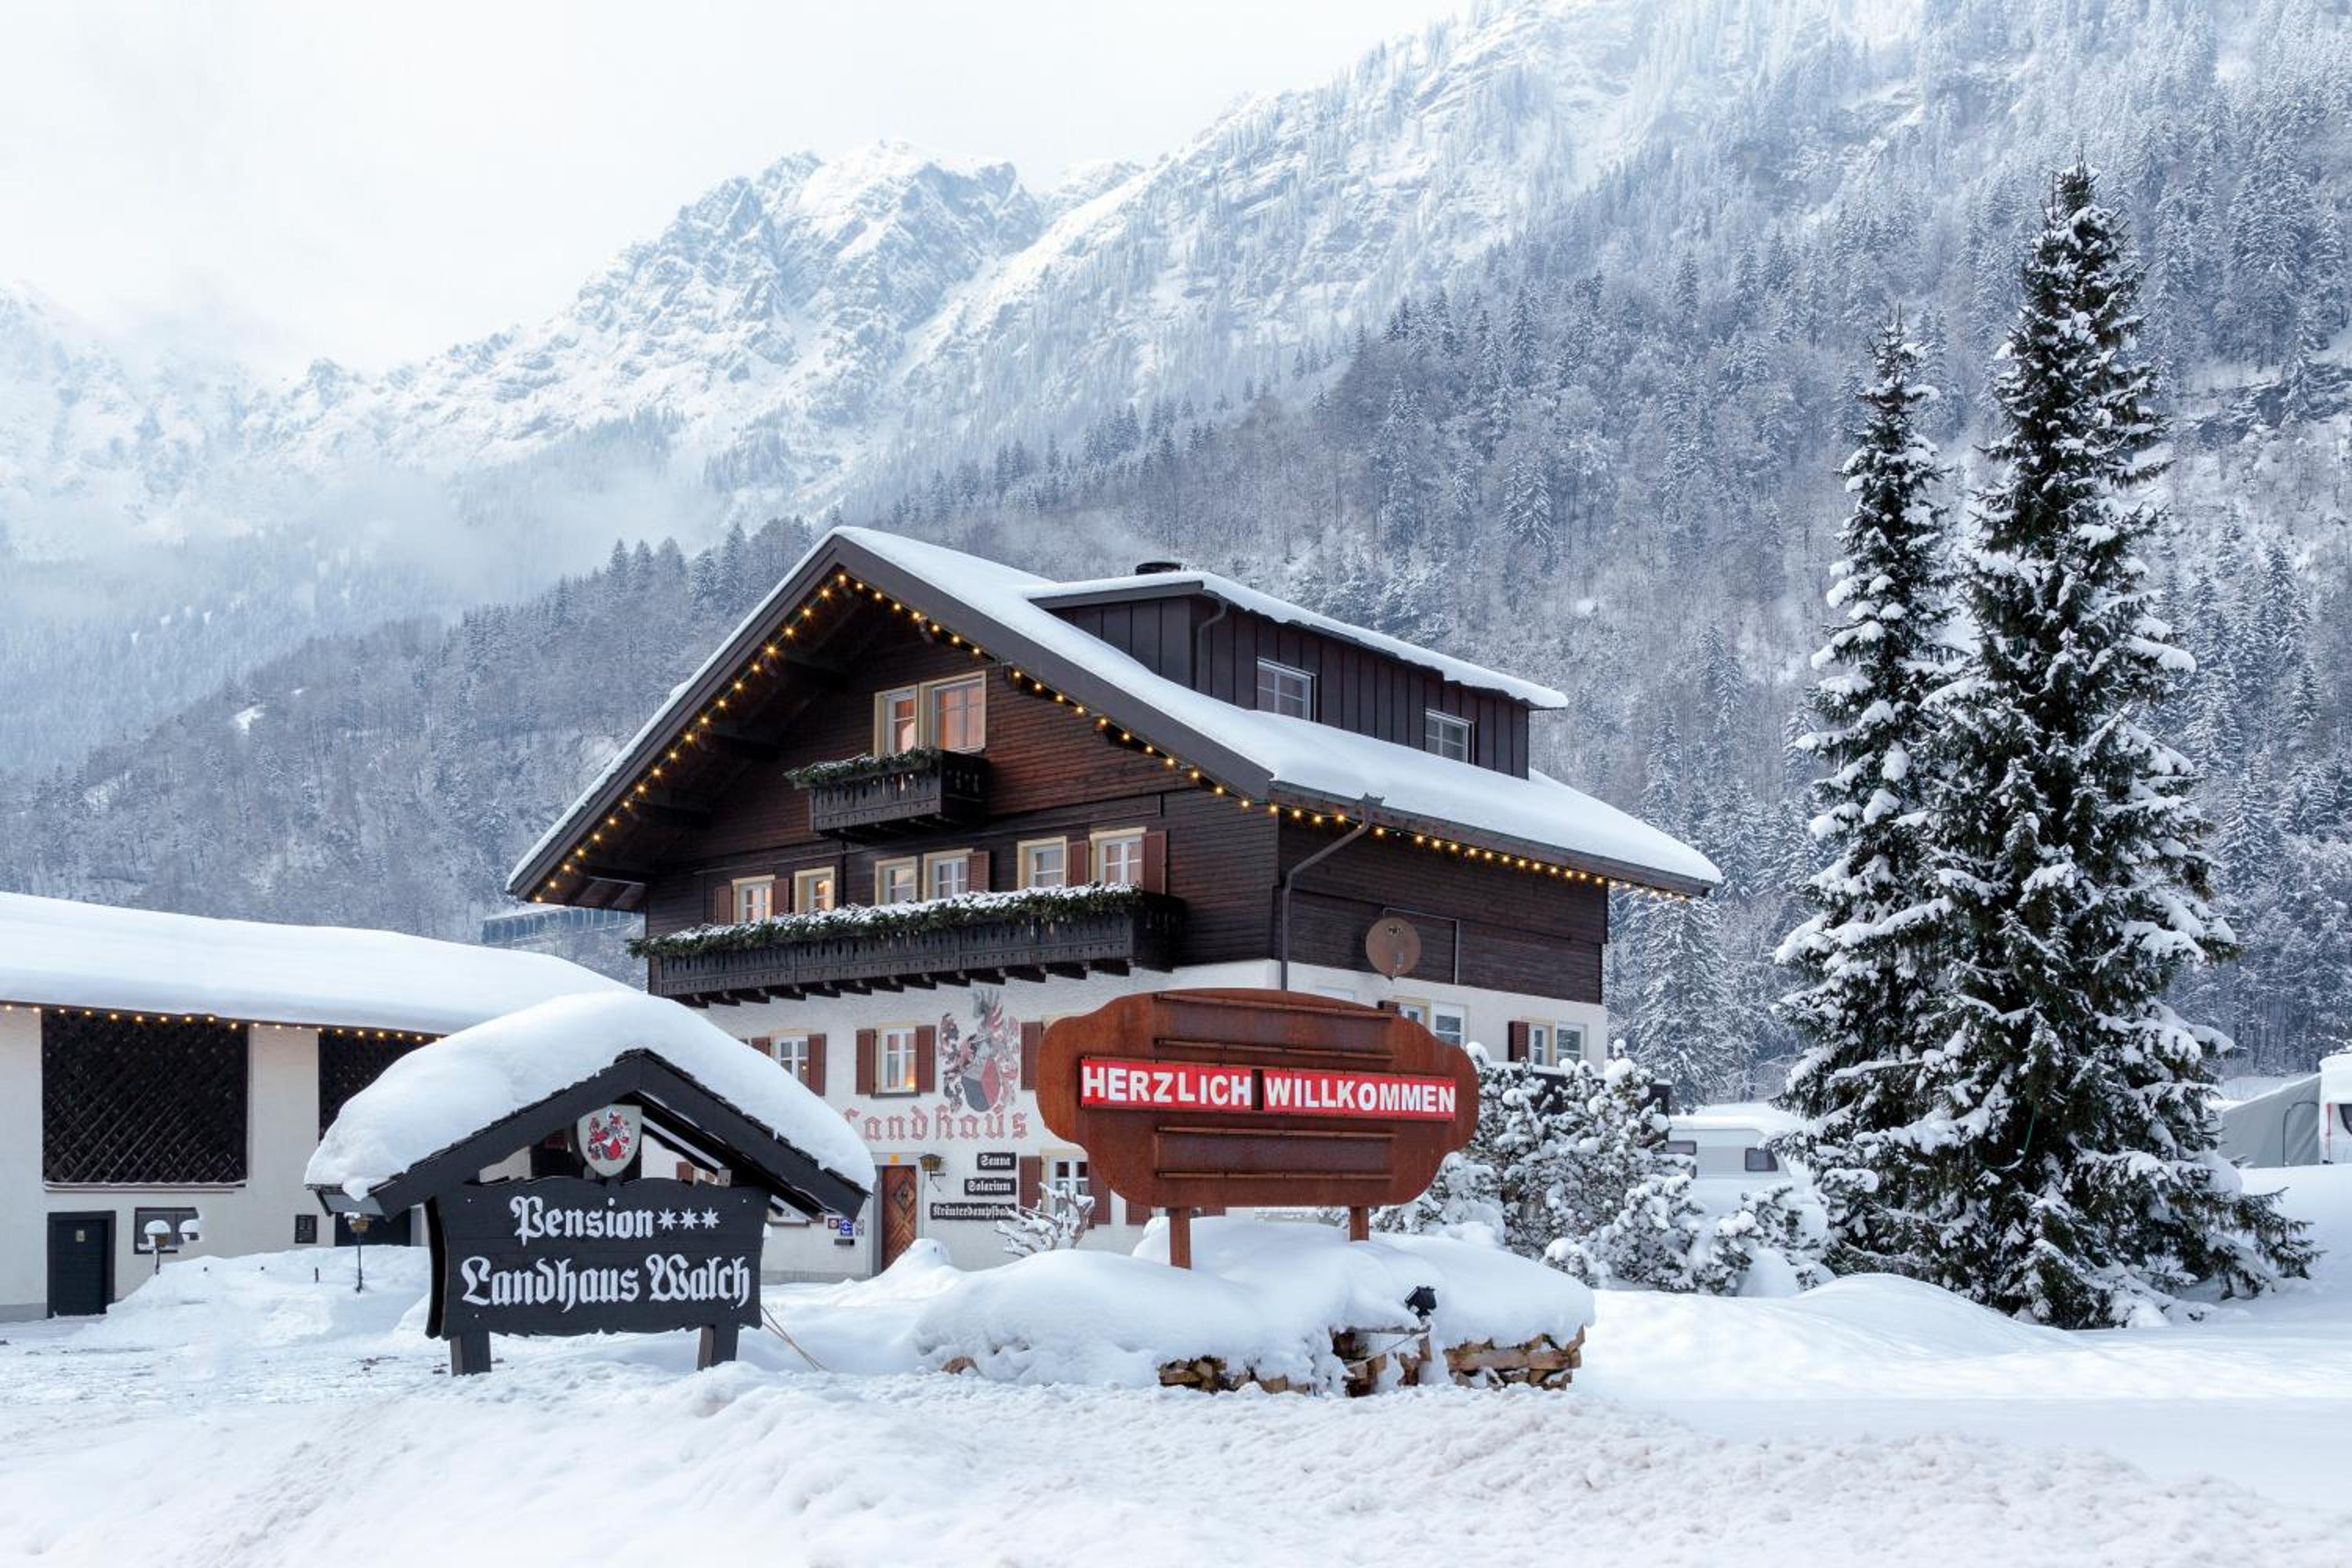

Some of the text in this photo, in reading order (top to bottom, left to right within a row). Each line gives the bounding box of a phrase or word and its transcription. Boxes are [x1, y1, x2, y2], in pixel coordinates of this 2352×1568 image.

[1082, 1066, 1455, 1113] HERZLICH WILLKOMMEN
[980, 1155, 1011, 1167] Sauna
[967, 1180, 1010, 1192] Solarium
[510, 1196, 654, 1247] Pension
[460, 1254, 750, 1312] Landhaus Walch
